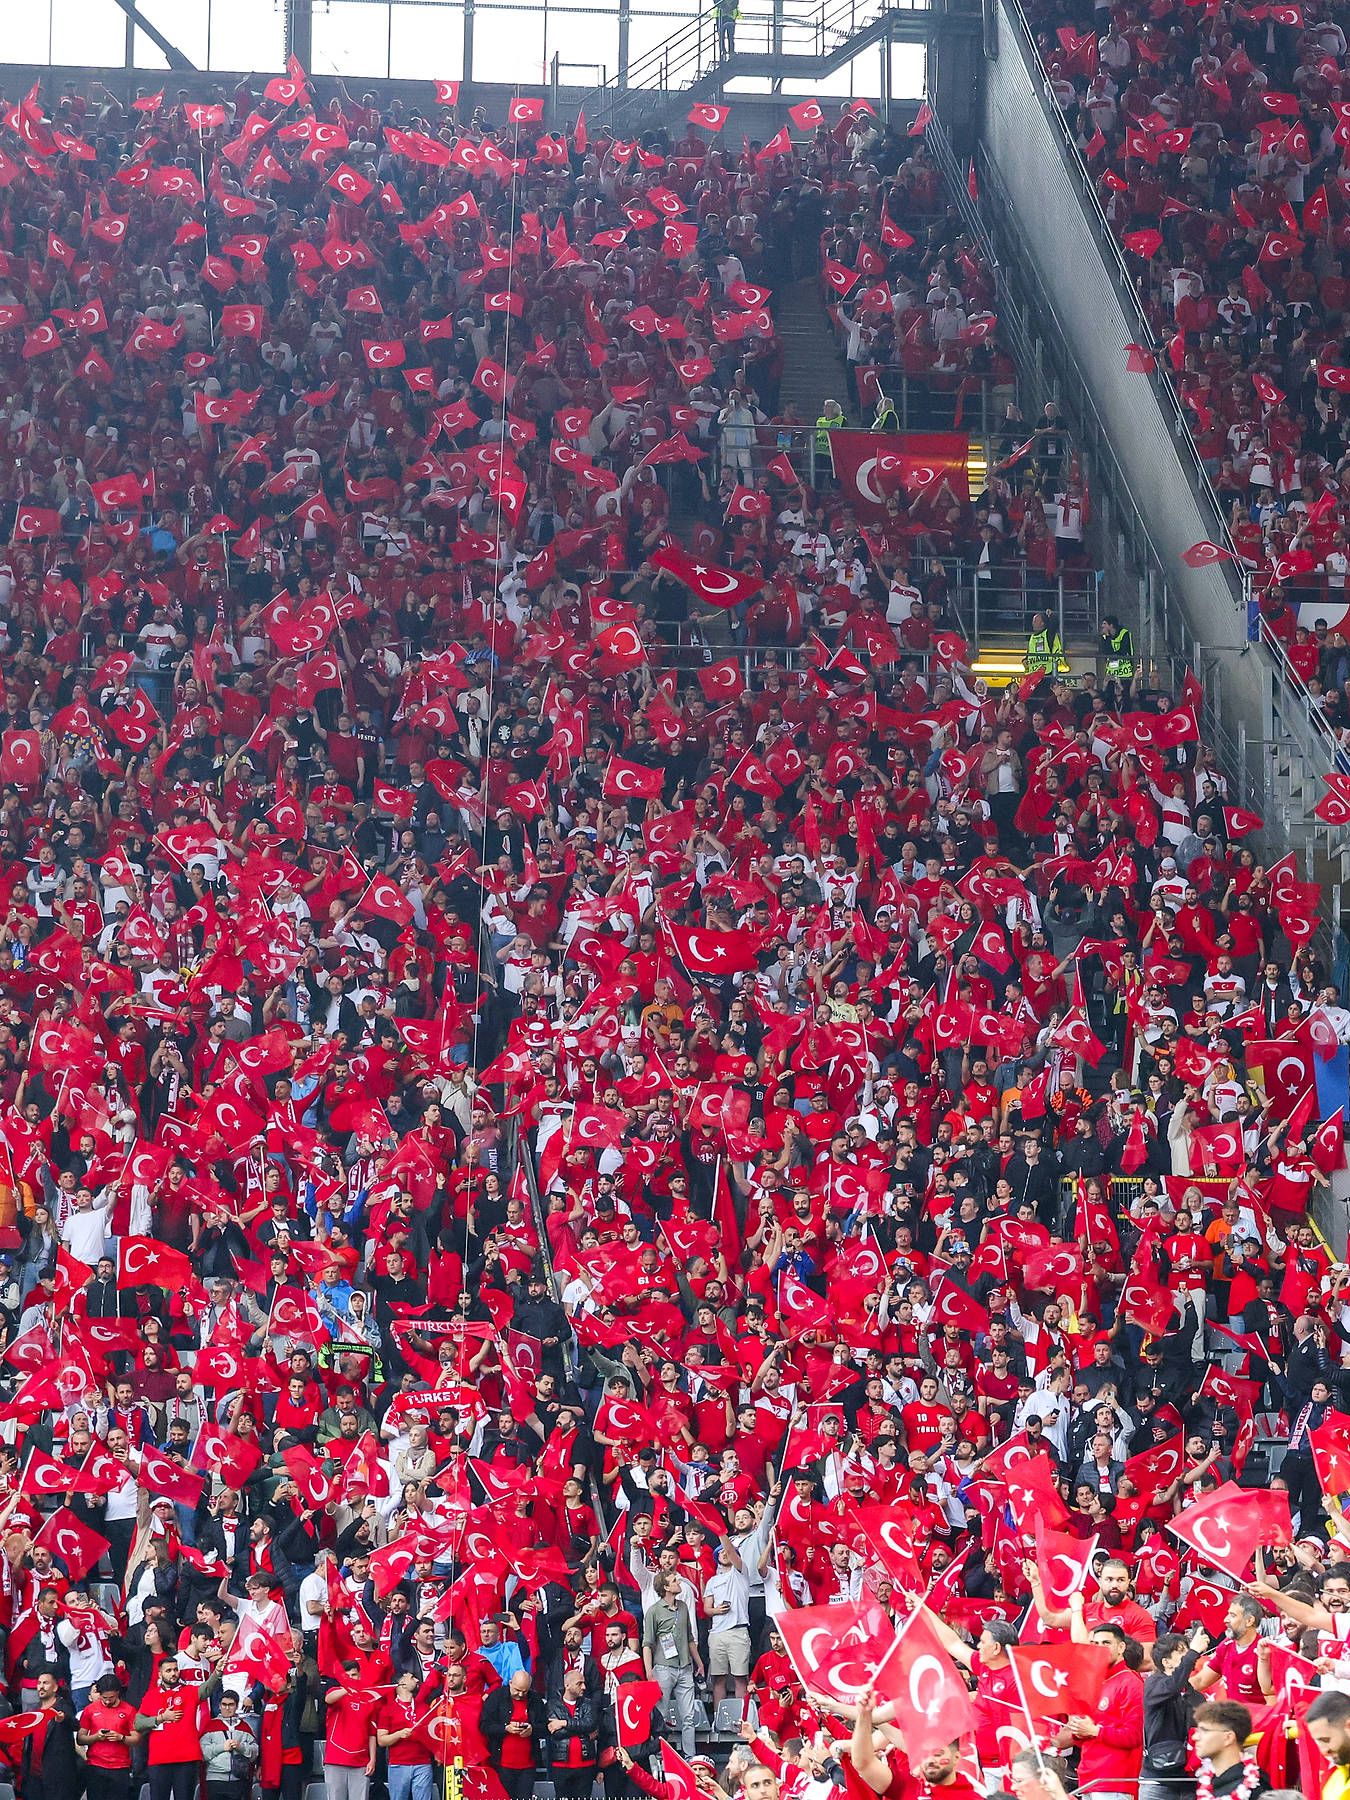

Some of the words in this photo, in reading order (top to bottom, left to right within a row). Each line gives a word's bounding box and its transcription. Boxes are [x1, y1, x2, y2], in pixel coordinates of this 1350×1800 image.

[756, 1091, 764, 1101] B
[637, 1276, 650, 1285] 61
[917, 1413, 928, 1422] 10
